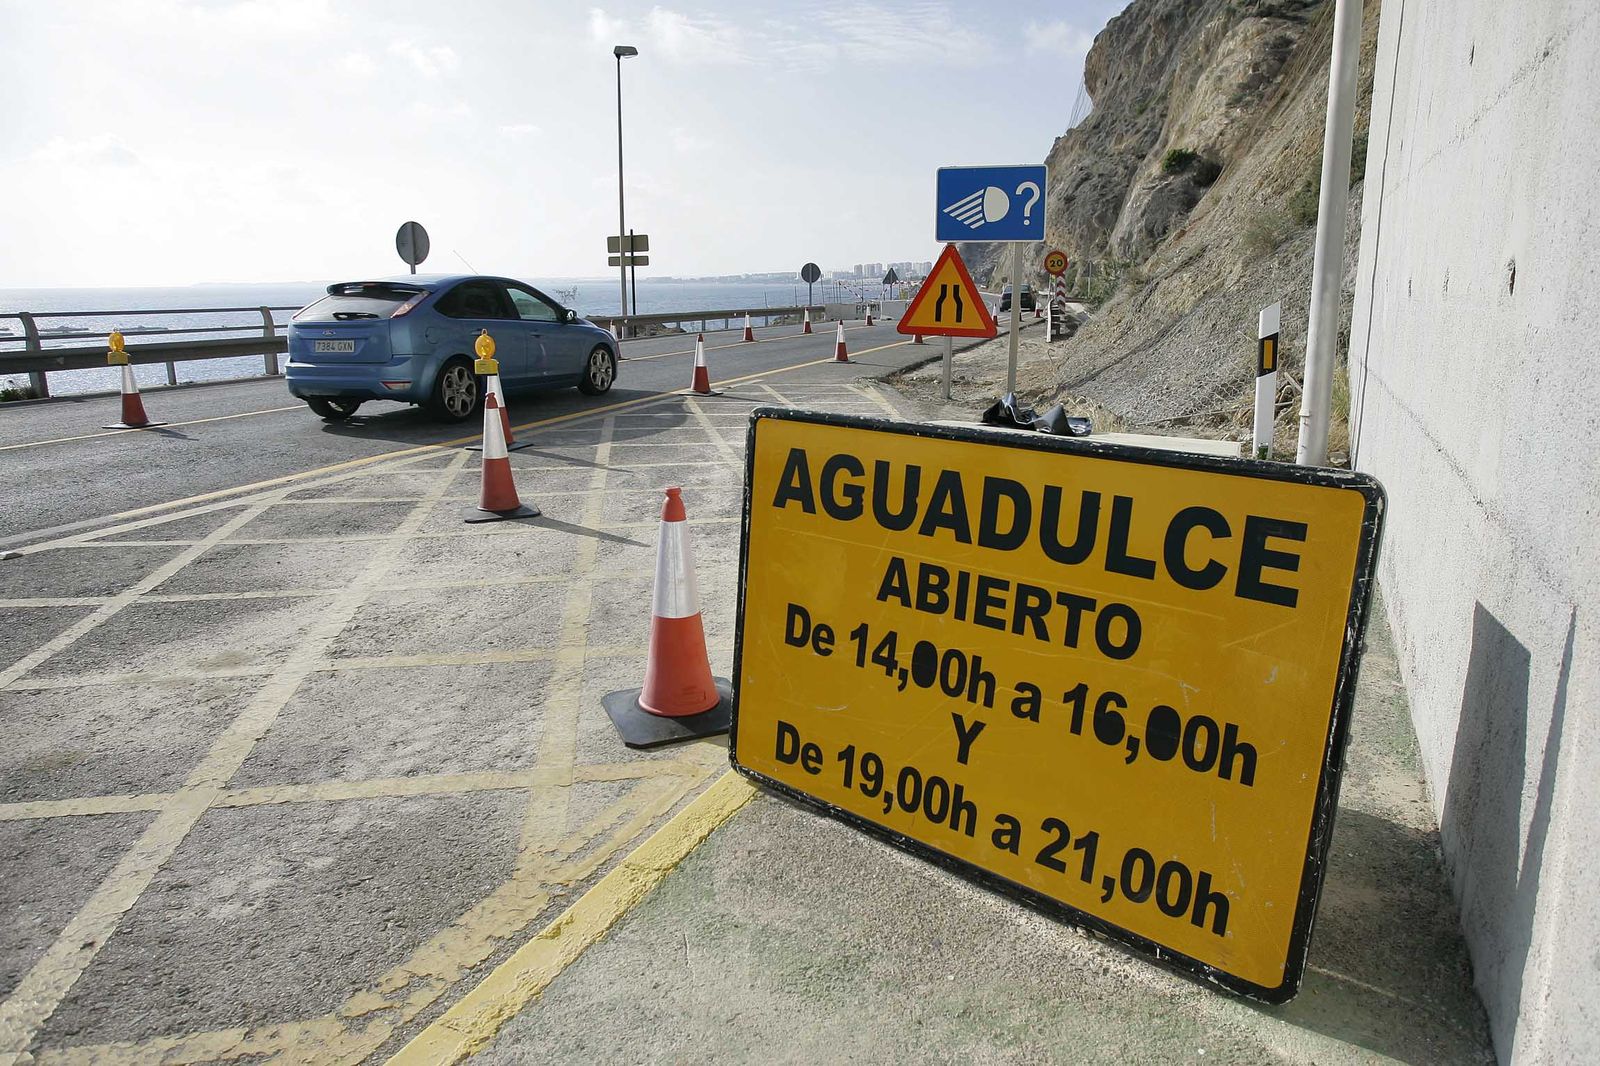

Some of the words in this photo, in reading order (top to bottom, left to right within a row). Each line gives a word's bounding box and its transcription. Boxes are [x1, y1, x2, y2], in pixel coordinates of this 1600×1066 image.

[1049, 259, 1063, 268] 20
[316, 341, 336, 351] 7384
[337, 341, 353, 351] GXN
[772, 447, 1309, 609] AGUADULCE
[876, 556, 1142, 661] ABIERTO
[784, 602, 836, 657] De
[849, 622, 997, 709] 14,00h
[1010, 681, 1042, 724] a
[1062, 682, 1258, 788] 16,00h
[951, 711, 987, 766] Y
[775, 719, 824, 776] De
[837, 744, 978, 838] 19,00h
[991, 813, 1022, 857] a
[1034, 817, 1230, 938] 21,00h
